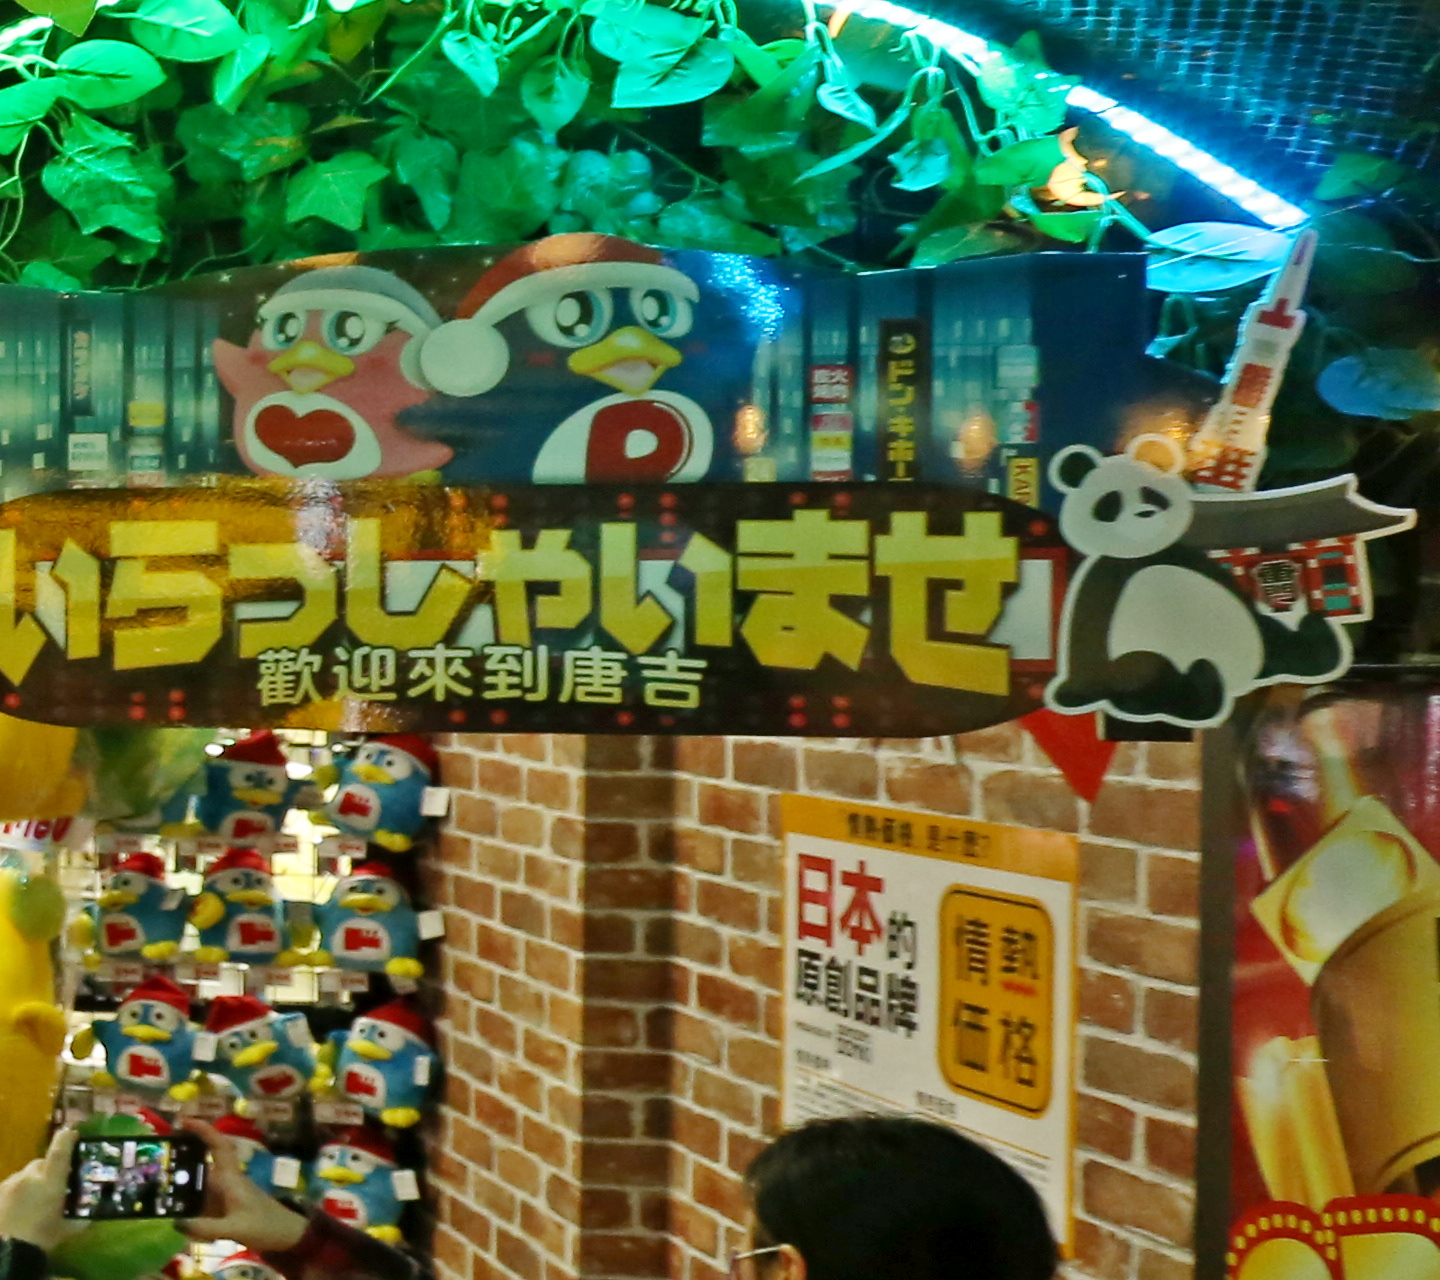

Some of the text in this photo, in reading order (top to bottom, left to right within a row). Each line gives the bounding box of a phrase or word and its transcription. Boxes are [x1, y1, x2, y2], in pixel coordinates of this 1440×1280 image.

[255, 648, 702, 711] 歡迎來到唐吉
